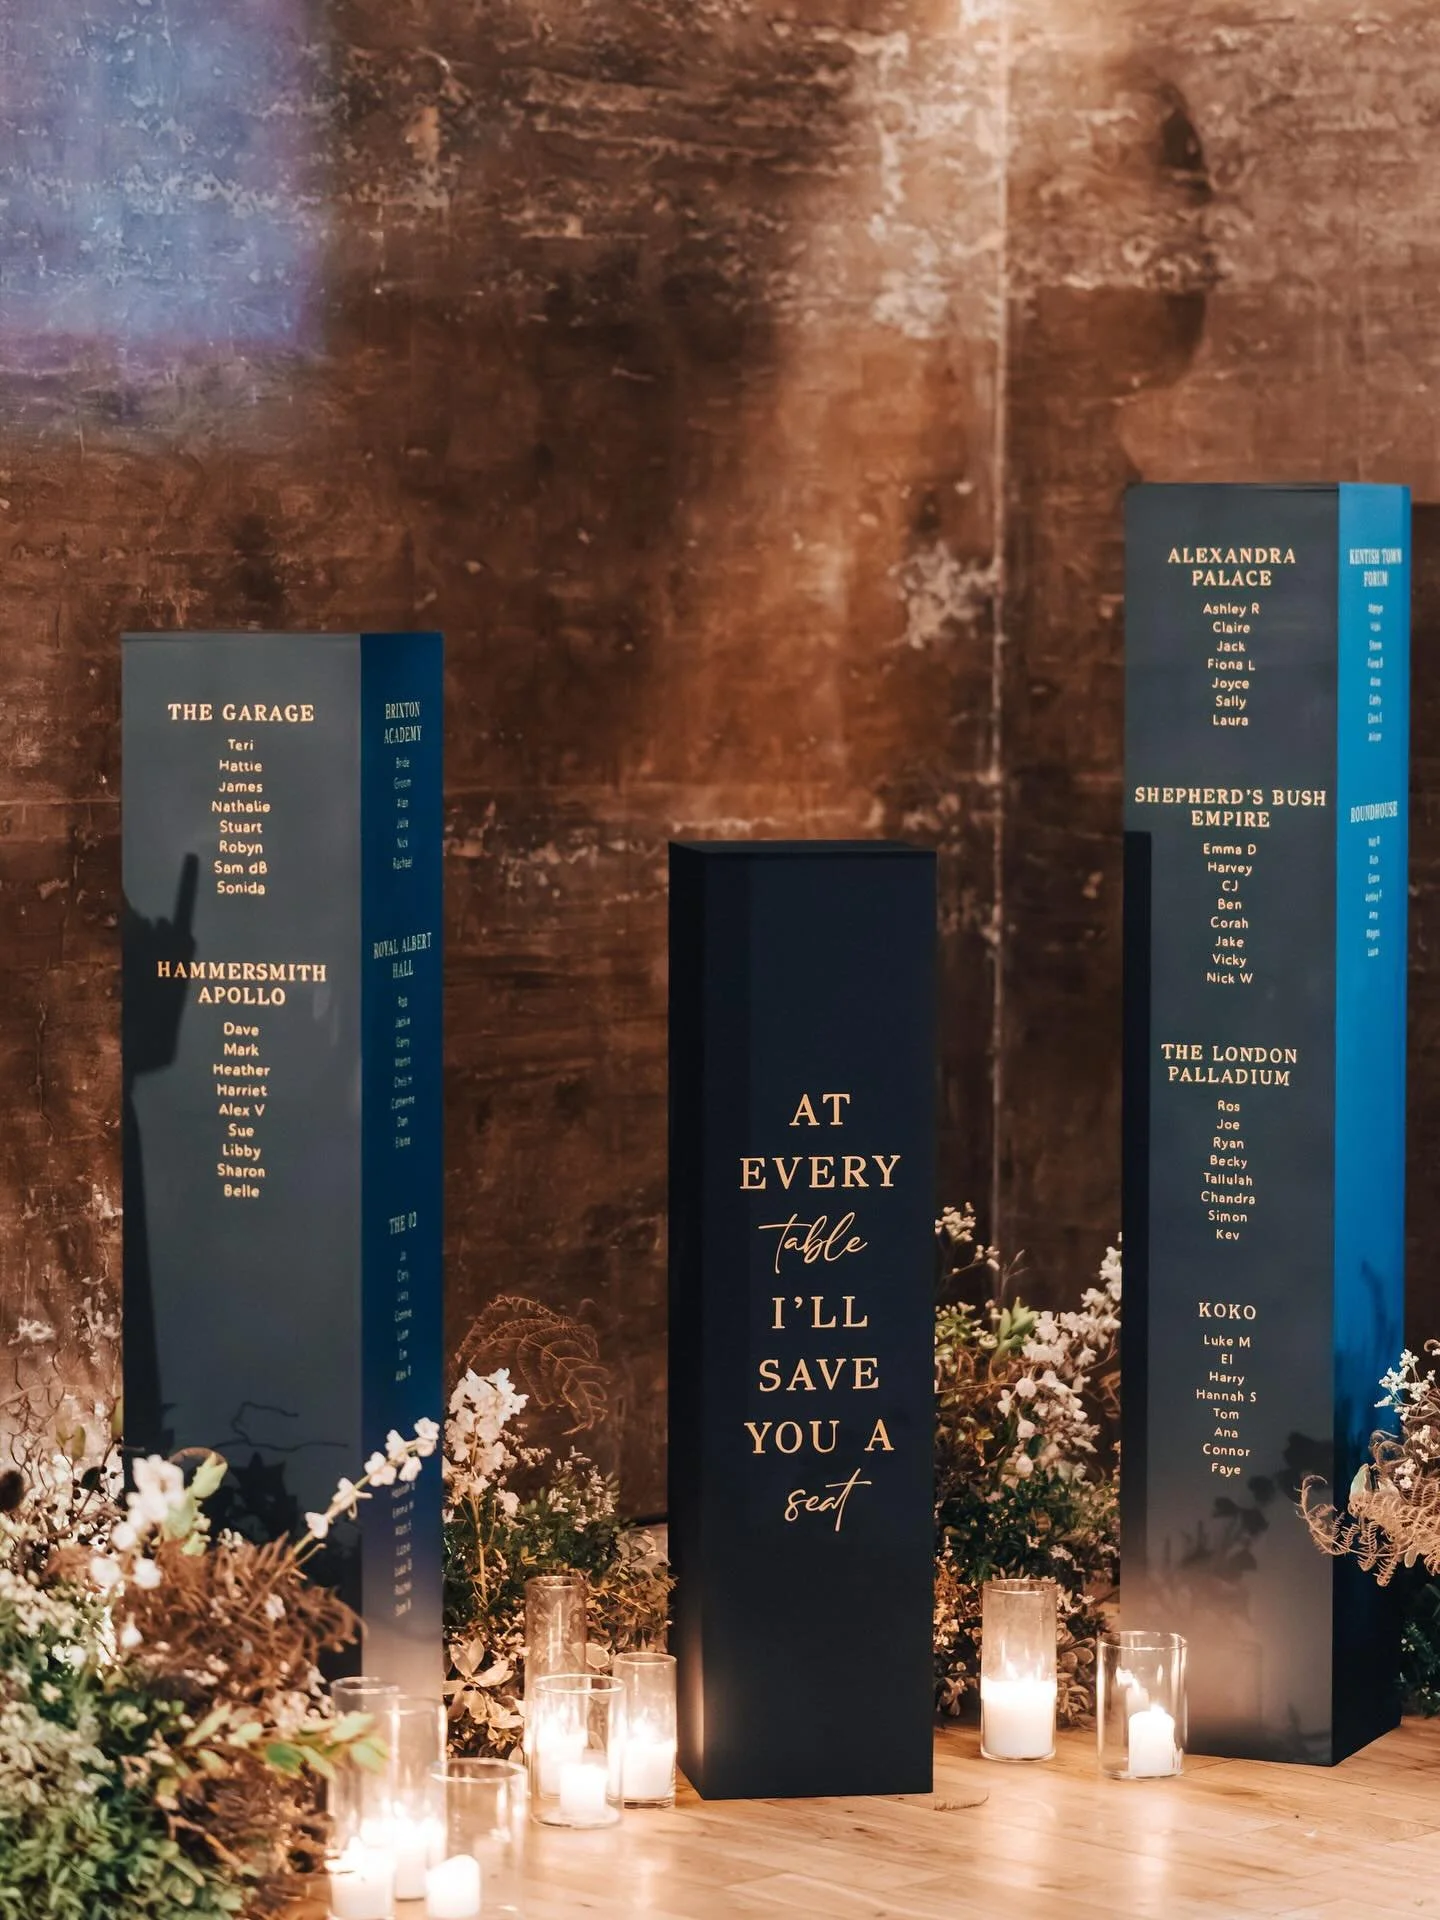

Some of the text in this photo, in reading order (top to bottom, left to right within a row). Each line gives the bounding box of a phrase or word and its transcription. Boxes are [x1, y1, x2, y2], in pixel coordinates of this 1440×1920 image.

[1168, 548, 1295, 563] ALEXANDRA
[1381, 549, 1401, 564] TOWN
[1193, 570, 1271, 586] PALACE
[1364, 571, 1387, 587] FORUM
[1203, 603, 1259, 617] Ashley R
[1213, 622, 1250, 633] Claire
[1217, 641, 1245, 652] Jack
[1208, 659, 1255, 670] Fiona L
[1212, 678, 1249, 691] Joyce
[1216, 695, 1246, 710] Sally
[168, 704, 313, 722] THE GARAGE
[386, 702, 420, 719] BRIXTON
[1213, 715, 1248, 726] Laura
[384, 726, 421, 744] ACADEMY
[228, 739, 253, 751] Teri
[220, 760, 262, 772] Hattie
[219, 782, 262, 792] James
[1135, 787, 1325, 806] SHEPHERD'S BUSH
[212, 800, 270, 812] Nathalie
[1351, 801, 1397, 823] ROUNDHOUSE
[1192, 810, 1269, 827] EMPIRE
[220, 820, 262, 833] Stuart
[220, 840, 262, 856] Robyn
[1204, 843, 1256, 855] Emma D
[215, 861, 267, 874] Sam dB
[1208, 862, 1252, 876] Harvey
[218, 881, 265, 895] Sonida
[1222, 880, 1238, 891] CJ
[1218, 898, 1241, 909] Ben
[1211, 916, 1248, 928] Corah
[374, 932, 431, 959] ROYAL ALBERT
[1216, 936, 1244, 947] Jake
[1213, 954, 1246, 968] Vicky
[157, 961, 326, 982] HAMMERSMITH
[393, 960, 413, 978] HALL
[1207, 973, 1253, 983] Nick W
[199, 987, 285, 1005] APOLLO
[224, 1022, 259, 1036] Dave
[224, 1043, 259, 1056] Mark
[1161, 1044, 1296, 1063] THE LONDON
[213, 1064, 270, 1076] Heather
[1168, 1066, 1290, 1086] PALLADIUM
[217, 1084, 267, 1096] Harriet
[219, 1103, 264, 1116] Alex V
[789, 1094, 850, 1125] AT
[1218, 1100, 1239, 1111] Ros
[229, 1123, 254, 1136] Sue
[1217, 1119, 1240, 1130] Joe
[1214, 1137, 1244, 1150] Ryan
[223, 1144, 260, 1161] Libby
[1210, 1155, 1247, 1169] Becky
[218, 1163, 265, 1177] Sharon
[740, 1155, 900, 1189] EVERY
[1204, 1173, 1252, 1185] Tallulah
[224, 1184, 259, 1197] Belle
[1201, 1191, 1255, 1204] Chandra
[1209, 1210, 1247, 1222] Simon
[390, 1215, 405, 1234] THE
[1217, 1229, 1239, 1240] Kev
[759, 1212, 867, 1273] table
[772, 1296, 867, 1328] I'LL
[1199, 1303, 1256, 1319] KOKO
[1204, 1335, 1250, 1347] Luke M
[1222, 1354, 1232, 1364] El
[760, 1358, 878, 1391] SAVE
[1210, 1372, 1244, 1385] Harry
[1197, 1389, 1256, 1402] Hannah S
[1213, 1408, 1239, 1419] Tom
[744, 1419, 894, 1453] YOU A
[1214, 1427, 1238, 1438] Ana
[1203, 1443, 1250, 1456] Connor
[1212, 1463, 1240, 1477] Faye
[785, 1468, 872, 1531] seat
